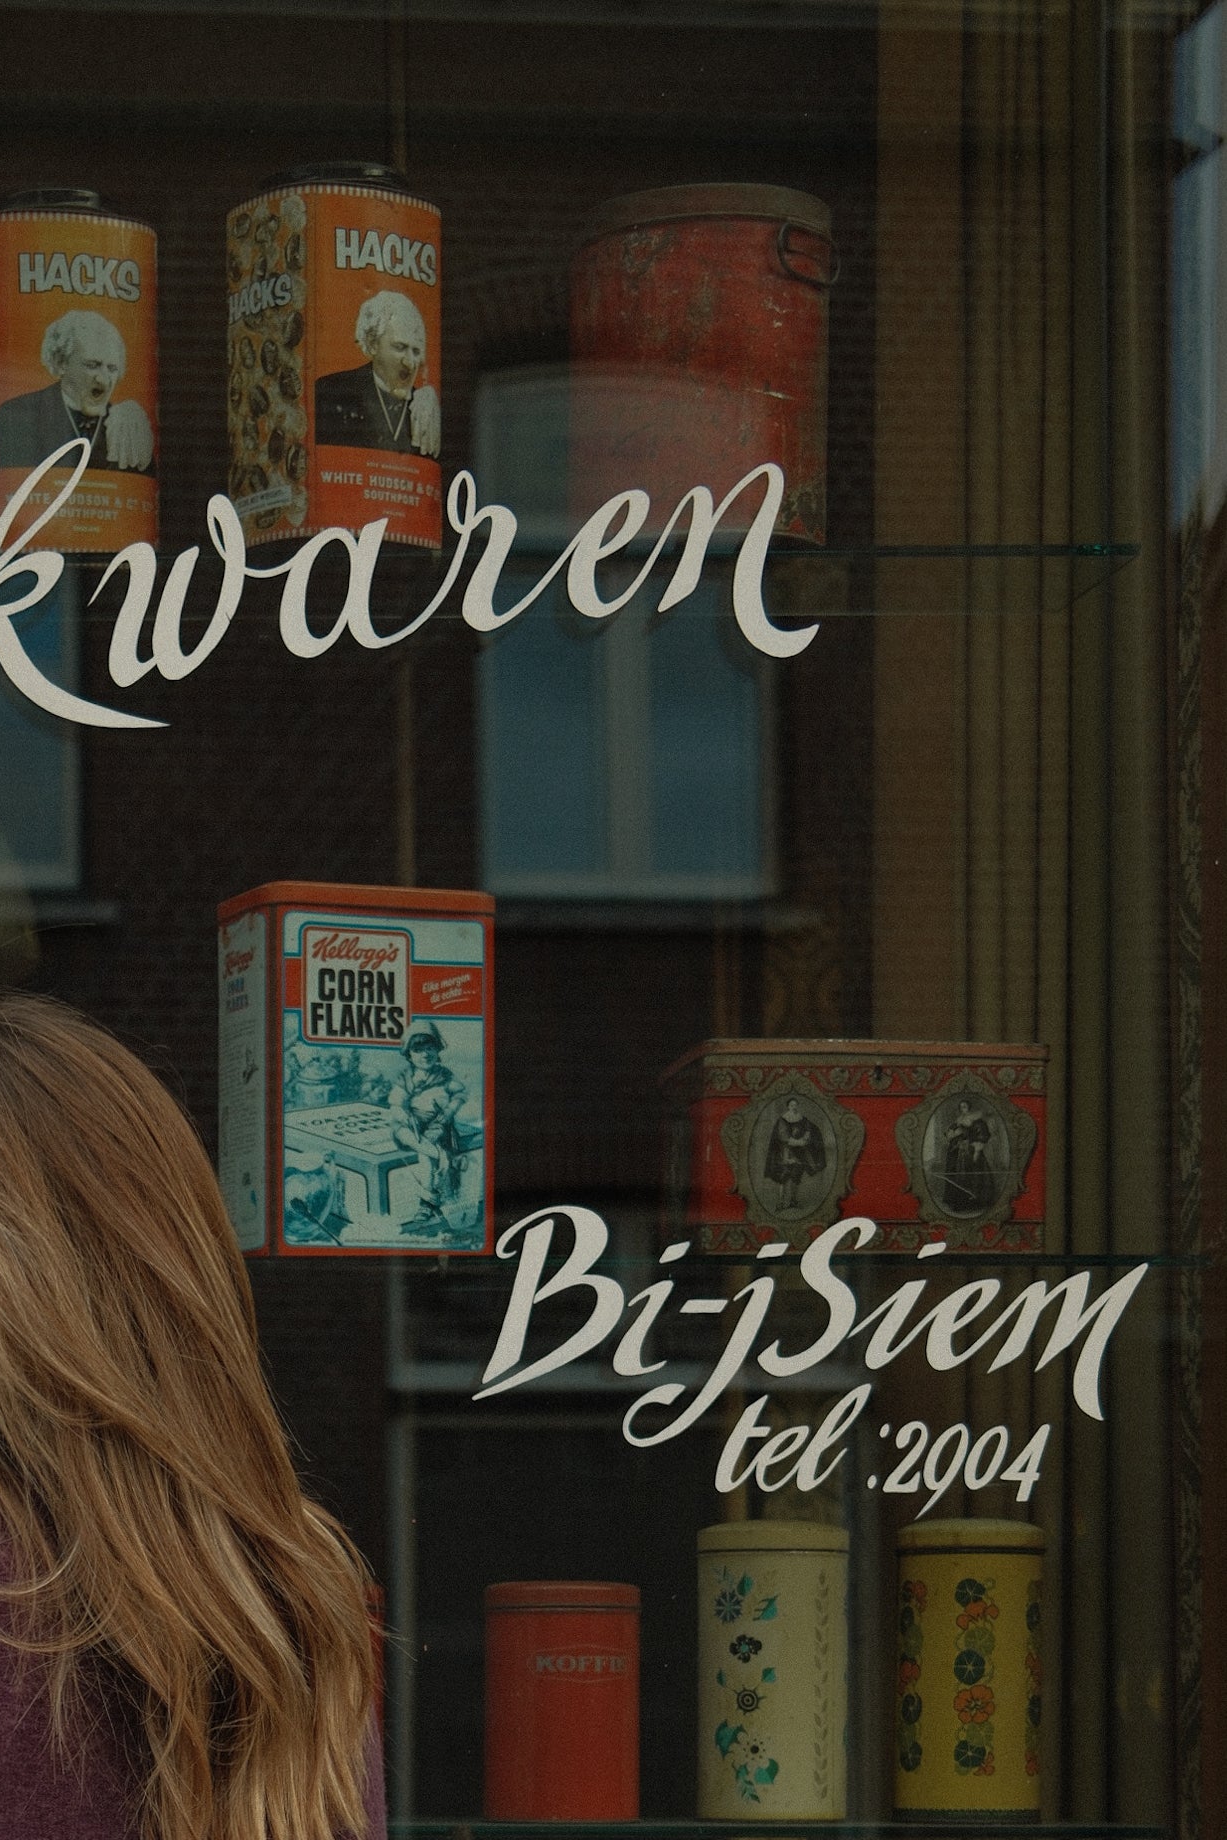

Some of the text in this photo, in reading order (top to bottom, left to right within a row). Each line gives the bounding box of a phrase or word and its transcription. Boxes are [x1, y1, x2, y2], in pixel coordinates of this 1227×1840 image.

[335, 227, 438, 287] HACKS
[17, 251, 142, 303] HACKS
[227, 273, 293, 325] HACKS
[320, 471, 364, 485] WHITE
[368, 475, 414, 490] HUDSON
[363, 488, 421, 507] SOUTHPORT
[312, 934, 399, 970] Kellogg's
[318, 968, 395, 1005] CORN
[310, 1002, 404, 1039] FLAKES
